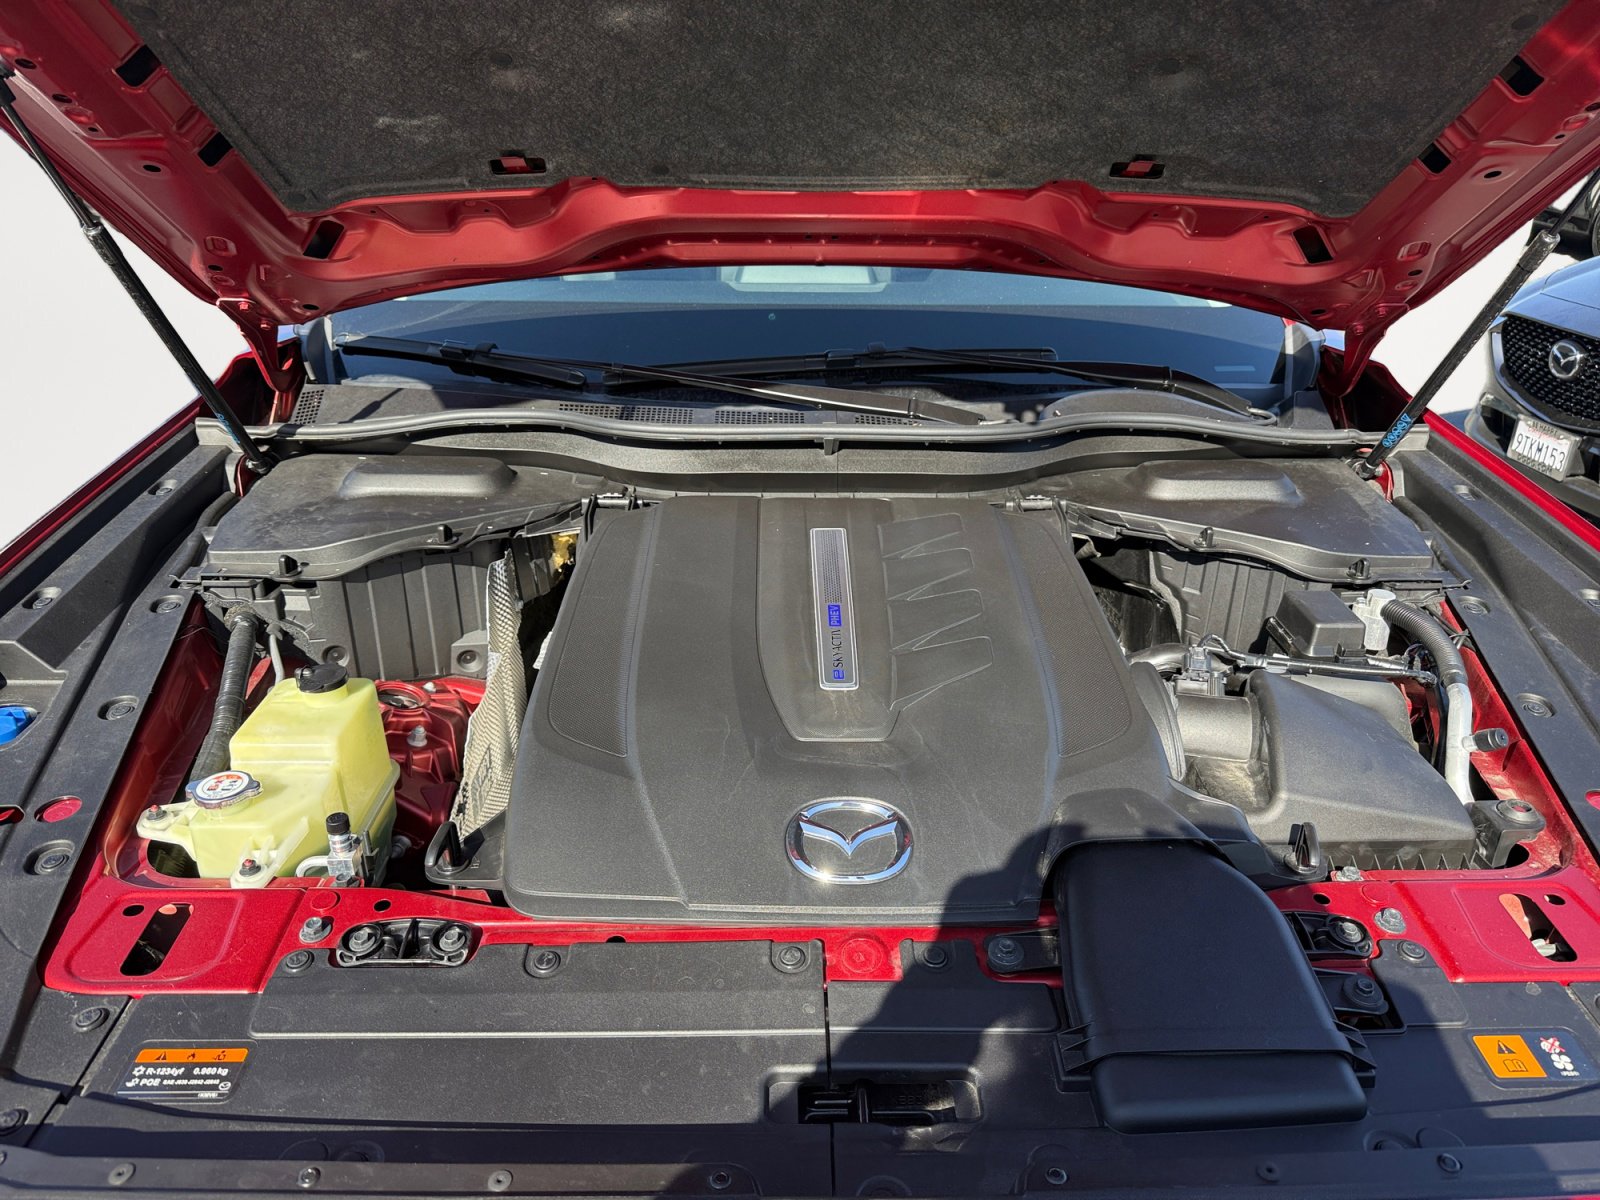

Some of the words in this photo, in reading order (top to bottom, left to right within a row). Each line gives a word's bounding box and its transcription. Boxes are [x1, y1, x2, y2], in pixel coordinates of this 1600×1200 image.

[1515, 432, 1566, 471] 9TKM153
[829, 605, 841, 626] PHEV
[145, 1067, 185, 1076] R-1234yf
[217, 1067, 229, 1077] kg
[139, 1078, 161, 1087] POE
